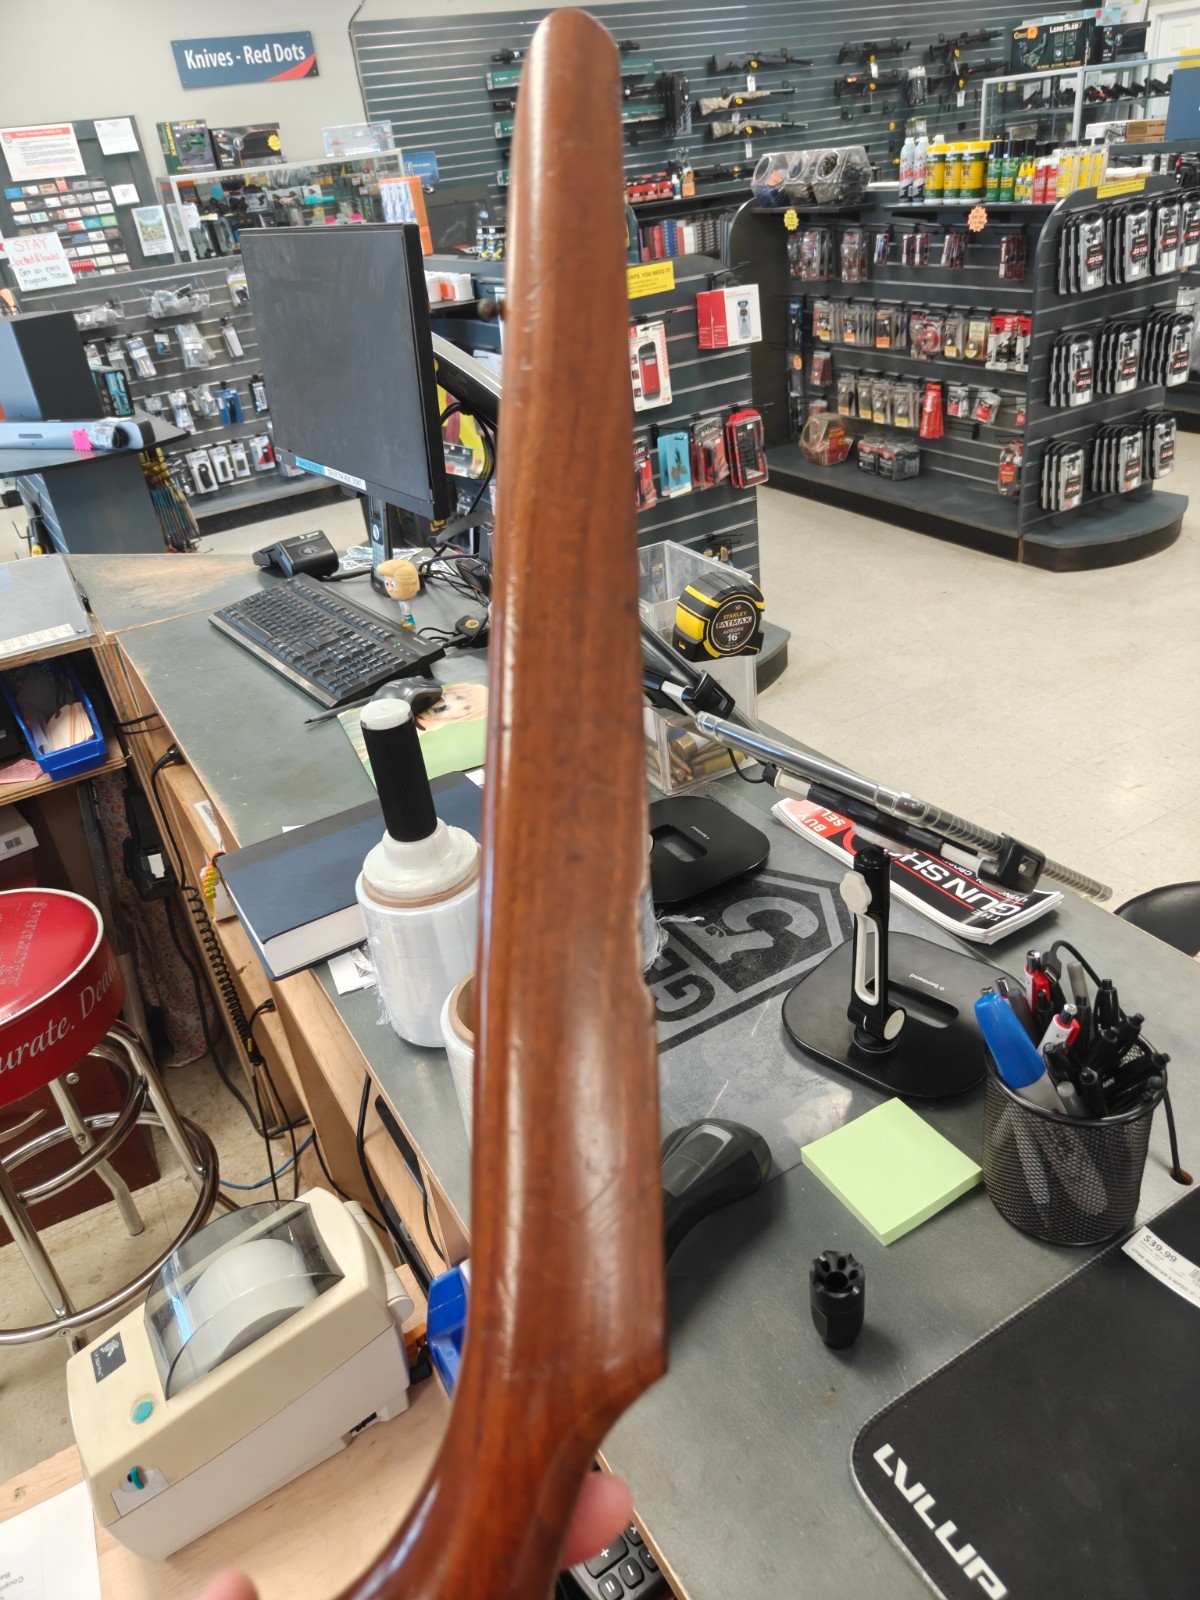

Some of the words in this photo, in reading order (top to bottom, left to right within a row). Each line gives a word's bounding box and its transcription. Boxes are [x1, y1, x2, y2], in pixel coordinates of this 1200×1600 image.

[184, 48, 234, 70] Knives
[243, 43, 272, 65] Red
[273, 43, 306, 62] Dots
[13, 237, 48, 252] STAY
[716, 616, 752, 630] FATMAX
[723, 611, 748, 620] STANLEY
[799, 814, 828, 832] BUY
[941, 877, 1022, 917] GUN
[971, 909, 1000, 921] THE
[0, 1016, 76, 1075] urate.
[1143, 1234, 1178, 1263] $39.99
